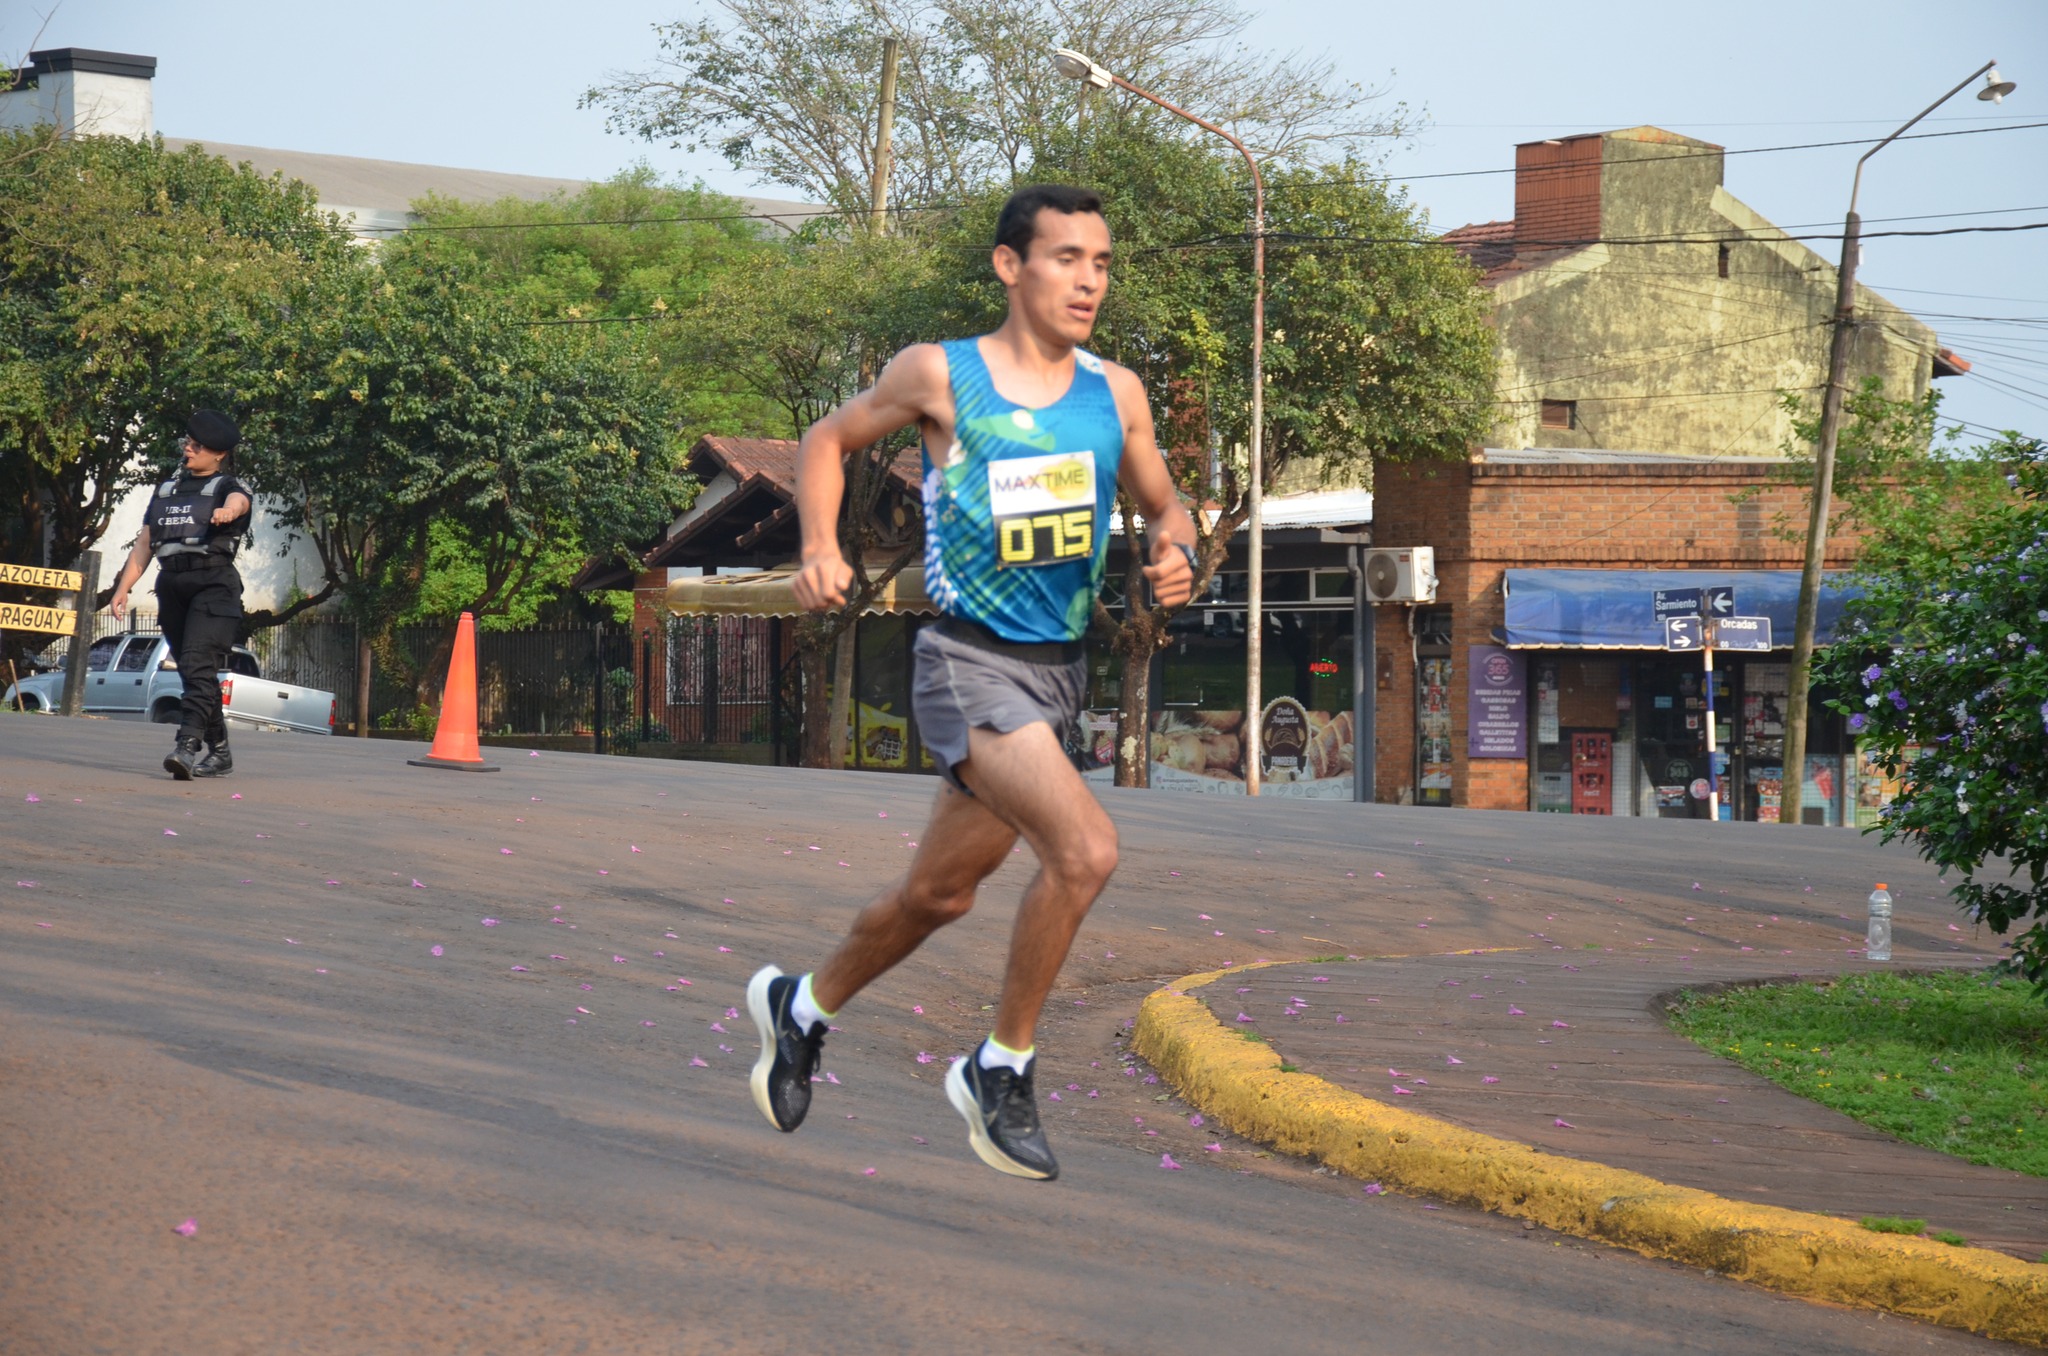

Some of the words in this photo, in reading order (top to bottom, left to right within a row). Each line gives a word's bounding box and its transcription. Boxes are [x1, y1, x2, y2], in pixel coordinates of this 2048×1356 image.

[995, 469, 1084, 493] MAXTIME
[1001, 511, 1092, 562] 075
[0, 566, 70, 588] AZOLETA
[1656, 592, 1667, 600] Av.
[1656, 600, 1697, 610] Sarmiento
[0, 607, 65, 629] RAGUAY
[1721, 619, 1758, 630] Orcadas
[1488, 664, 1509, 675] 365
